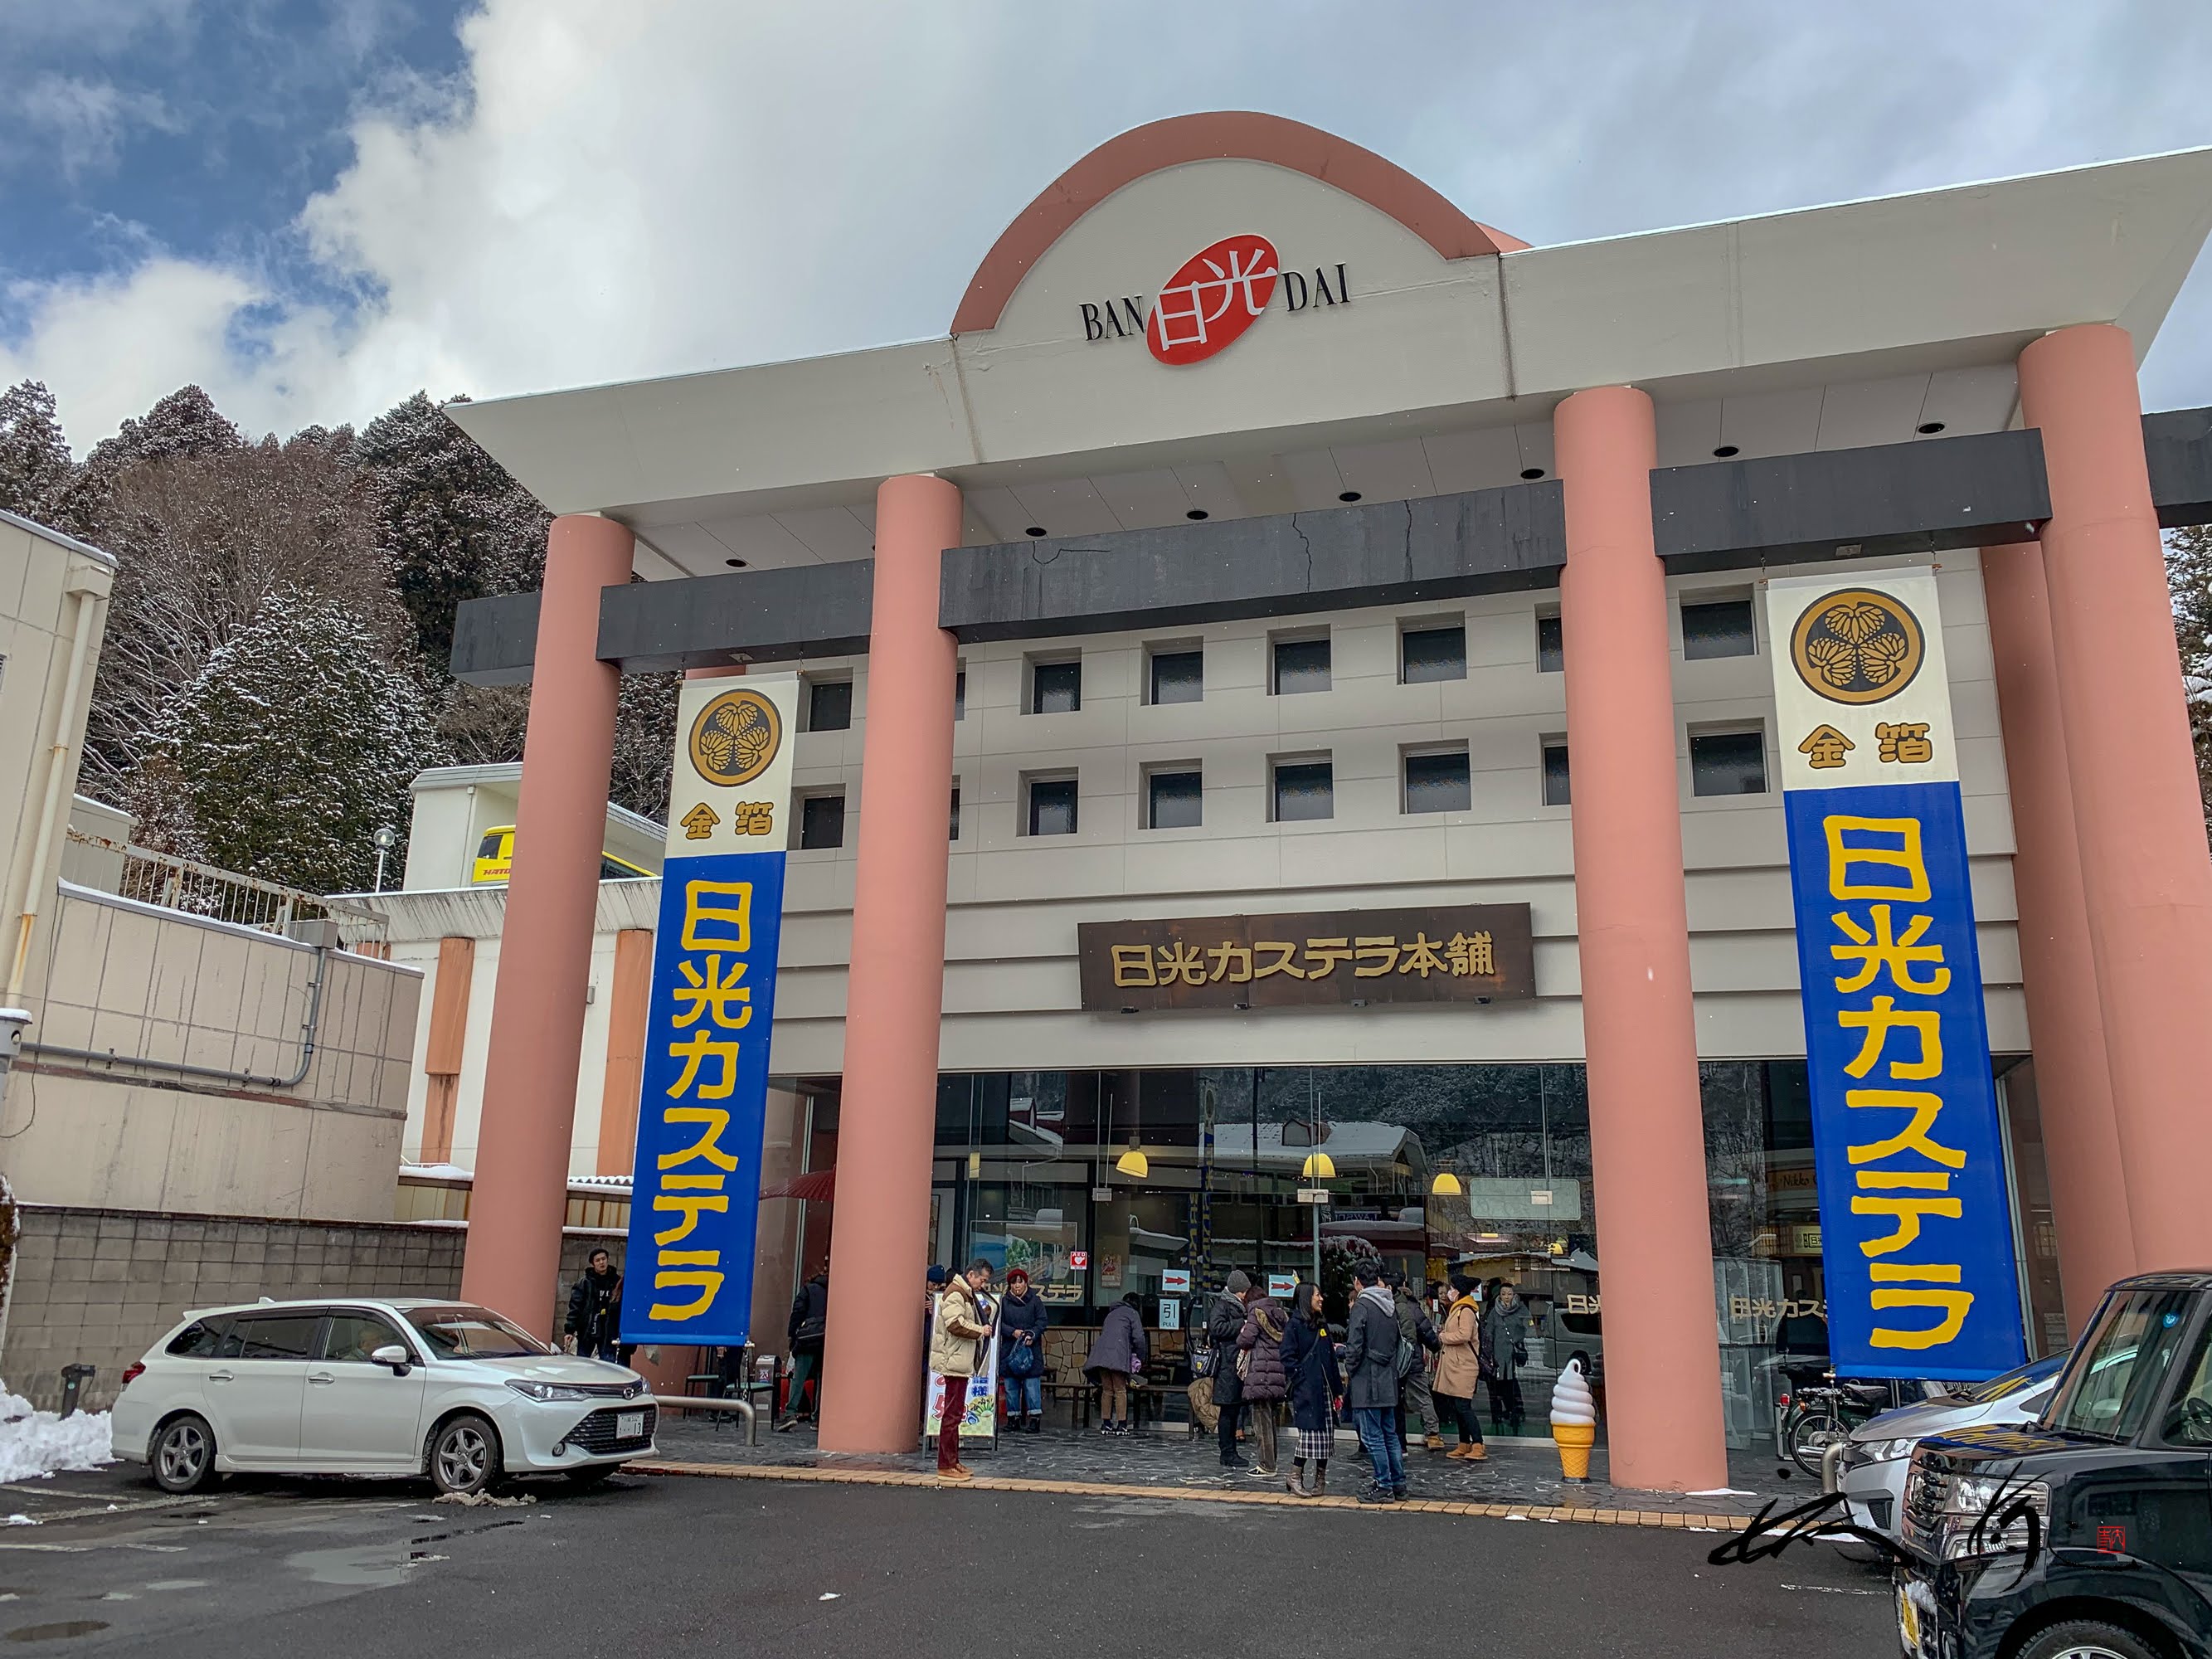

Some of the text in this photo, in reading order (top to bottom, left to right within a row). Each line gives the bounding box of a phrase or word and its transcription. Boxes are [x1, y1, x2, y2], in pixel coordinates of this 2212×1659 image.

[1078, 248, 1351, 352] BAN 日光 DAI
[1797, 722, 1933, 769] 金箔
[680, 801, 775, 840] 金箔
[1110, 930, 1495, 988] 日光カステラ本舗
[649, 879, 753, 1321] 日光カステラ
[1822, 815, 1975, 1350] 日光カステラ
[1163, 1303, 1176, 1319] 引
[1730, 1297, 1827, 1318] 日光カス
